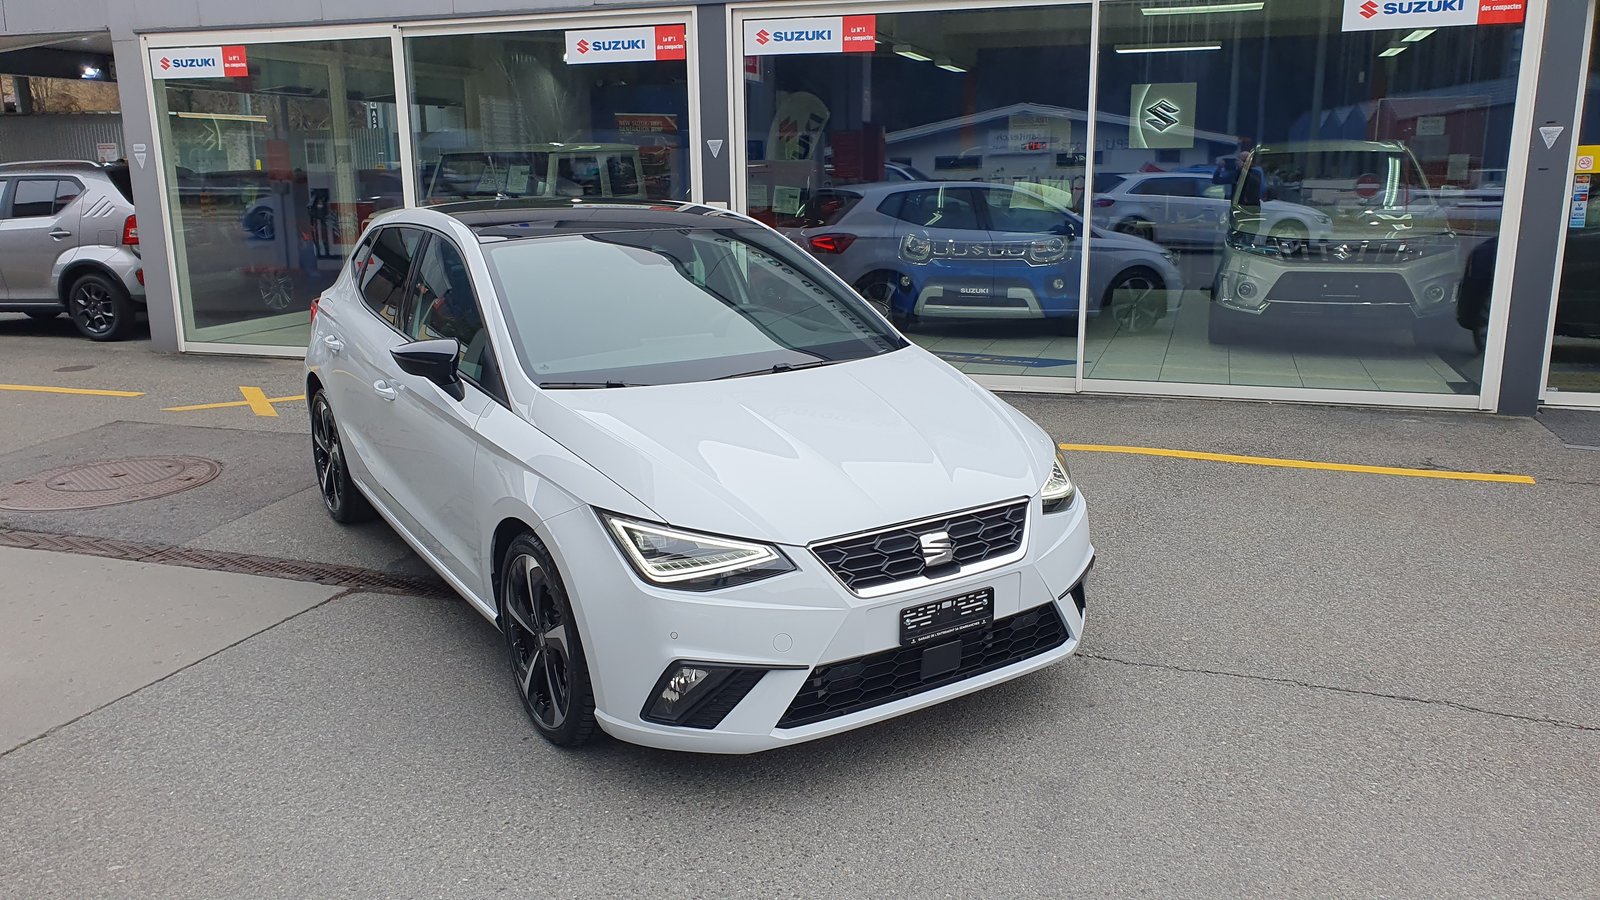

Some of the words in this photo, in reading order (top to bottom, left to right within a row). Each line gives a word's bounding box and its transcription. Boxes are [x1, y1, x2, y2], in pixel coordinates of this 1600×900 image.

[1383, 0, 1464, 14] SUZUKI
[1492, 3, 1522, 11] compactes
[773, 30, 832, 41] SUZUKI
[592, 40, 646, 51] SUZUKI
[172, 58, 216, 68] SUZUKI
